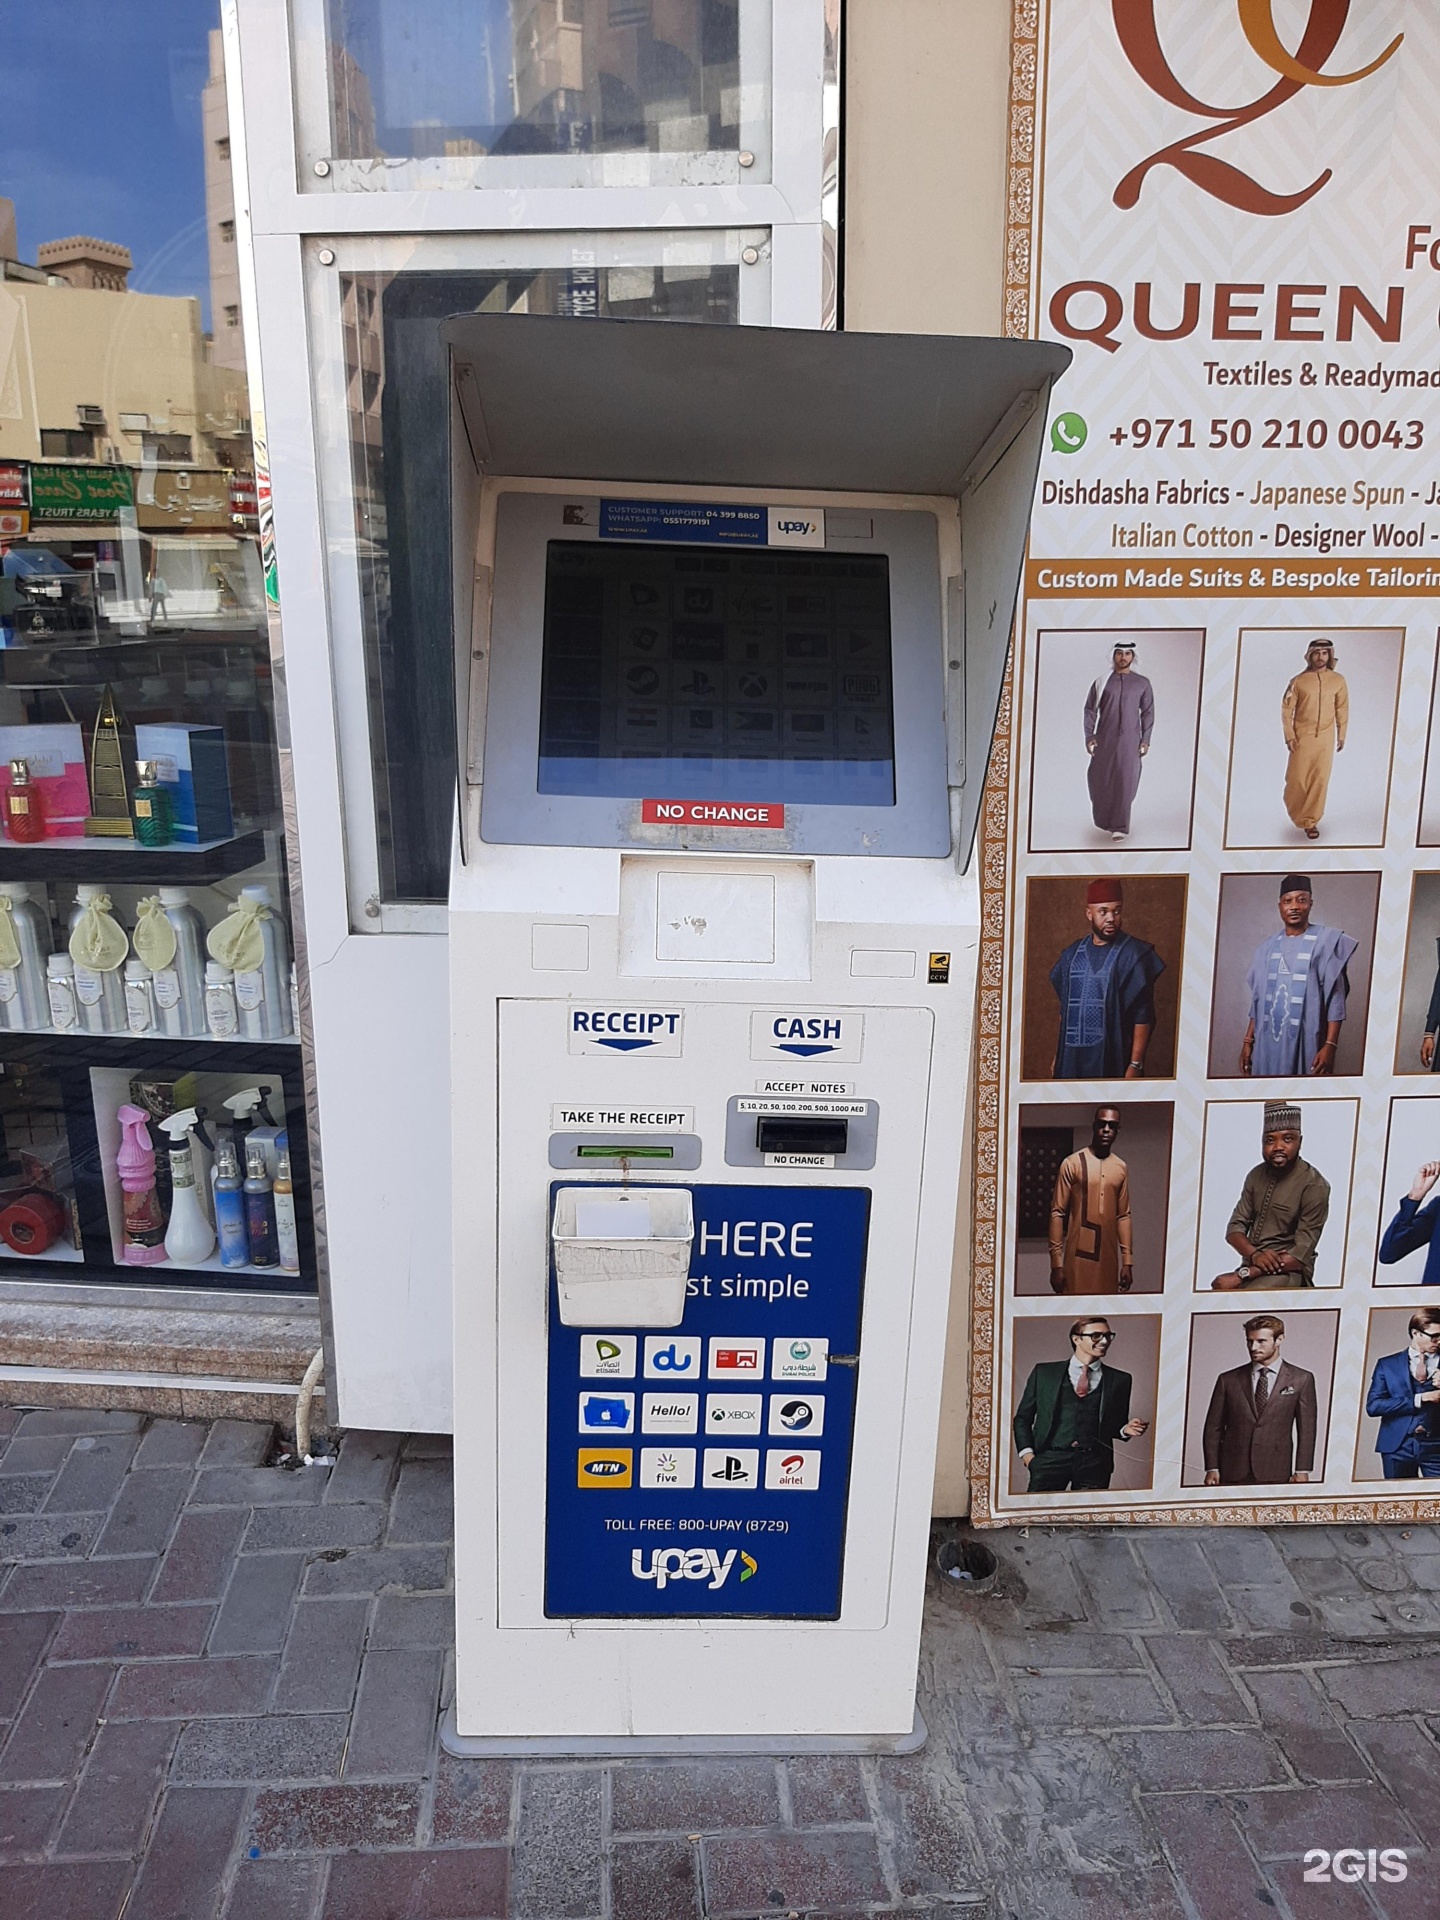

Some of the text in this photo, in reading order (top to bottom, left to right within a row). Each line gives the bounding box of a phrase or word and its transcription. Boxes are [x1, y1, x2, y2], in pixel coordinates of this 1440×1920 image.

[1049, 280, 1405, 354] QUEEN
[1202, 361, 1292, 386] Textiles
[1299, 362, 1318, 386] &
[1109, 419, 1424, 450] +971 50 210 0043
[1042, 479, 1149, 505] Dishdasha
[1156, 480, 1230, 506] Fabrics
[1249, 480, 1346, 511] Japanese
[1352, 481, 1404, 511] Spun
[608, 506, 760, 520] CUSTOMER SUPPORT: 04 399 8850
[608, 515, 661, 524] WHATSAPP:
[777, 520, 810, 535] upay
[1111, 522, 1176, 548] Italian
[1183, 523, 1253, 548] Cotton
[1274, 523, 1365, 553] Designer
[1372, 522, 1424, 548] Wool
[1037, 569, 1118, 588] Custom
[1124, 569, 1183, 588] Made
[1188, 568, 1243, 588] Suits
[1248, 569, 1266, 588] &
[1271, 568, 1360, 591] Bespoke
[656, 804, 769, 822] NO CHANGE
[573, 1011, 680, 1034] RECEIPT
[773, 1018, 841, 1040] CASH
[764, 1082, 846, 1094] ACCEPT NOTES
[561, 1111, 685, 1125] TAKE THE RECEIPT
[774, 1155, 825, 1165] NO CHANGE
[700, 1220, 813, 1257] HERE
[720, 1273, 809, 1303] simple
[652, 1344, 692, 1371] du
[650, 1405, 691, 1416] Hello!
[727, 1410, 756, 1419] XBOX
[591, 1463, 620, 1473] MTN
[656, 1473, 677, 1483] five
[779, 1476, 803, 1485] airtel
[604, 1519, 789, 1534] TOLL FREE: 800-UPAY (8729)
[631, 1548, 738, 1589] upay
